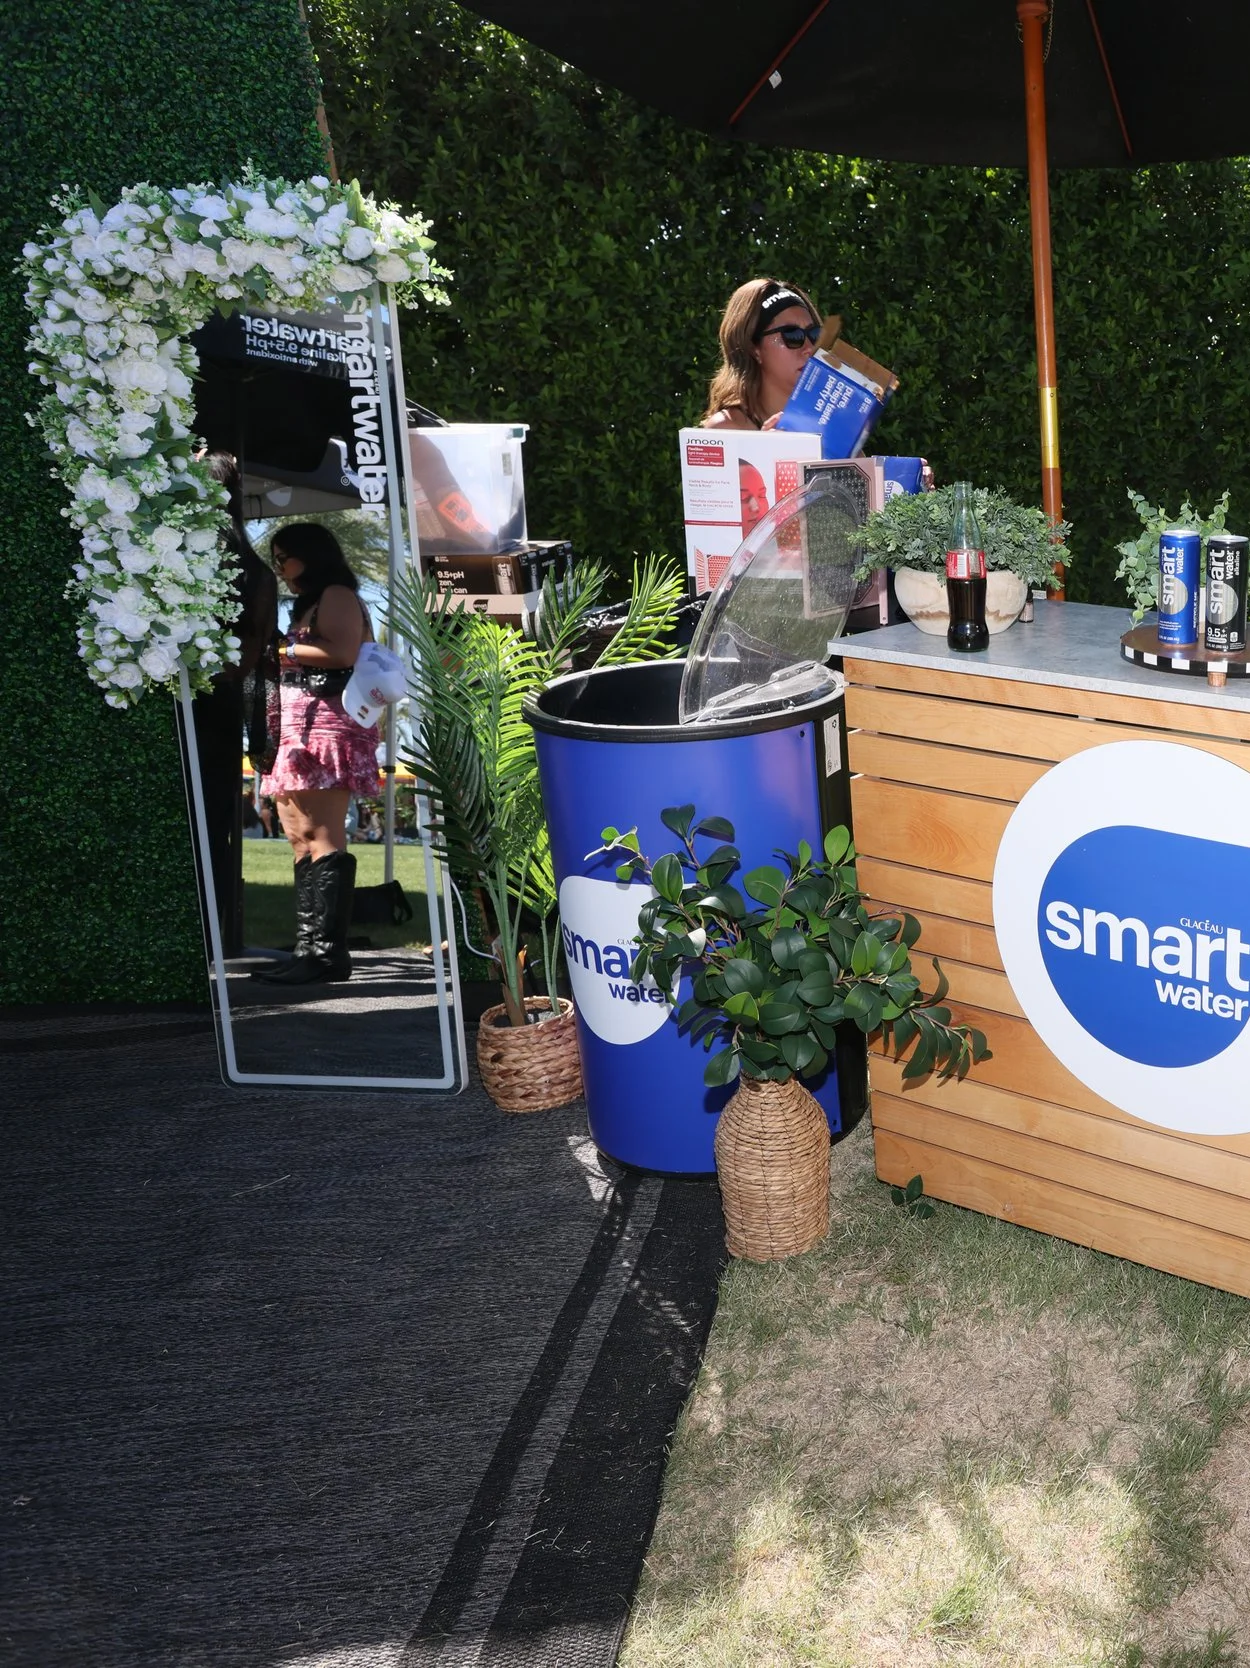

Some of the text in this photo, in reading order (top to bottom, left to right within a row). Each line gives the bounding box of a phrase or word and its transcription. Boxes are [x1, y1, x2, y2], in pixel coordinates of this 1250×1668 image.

[814, 374, 837, 412] party on
[1162, 546, 1176, 606] smart
[1176, 548, 1184, 574] water
[1226, 550, 1235, 579] water
[1210, 549, 1225, 615] smart
[1045, 900, 1250, 992] smart
[1180, 917, 1224, 935] GLACÉAU
[1154, 978, 1249, 1021] water
